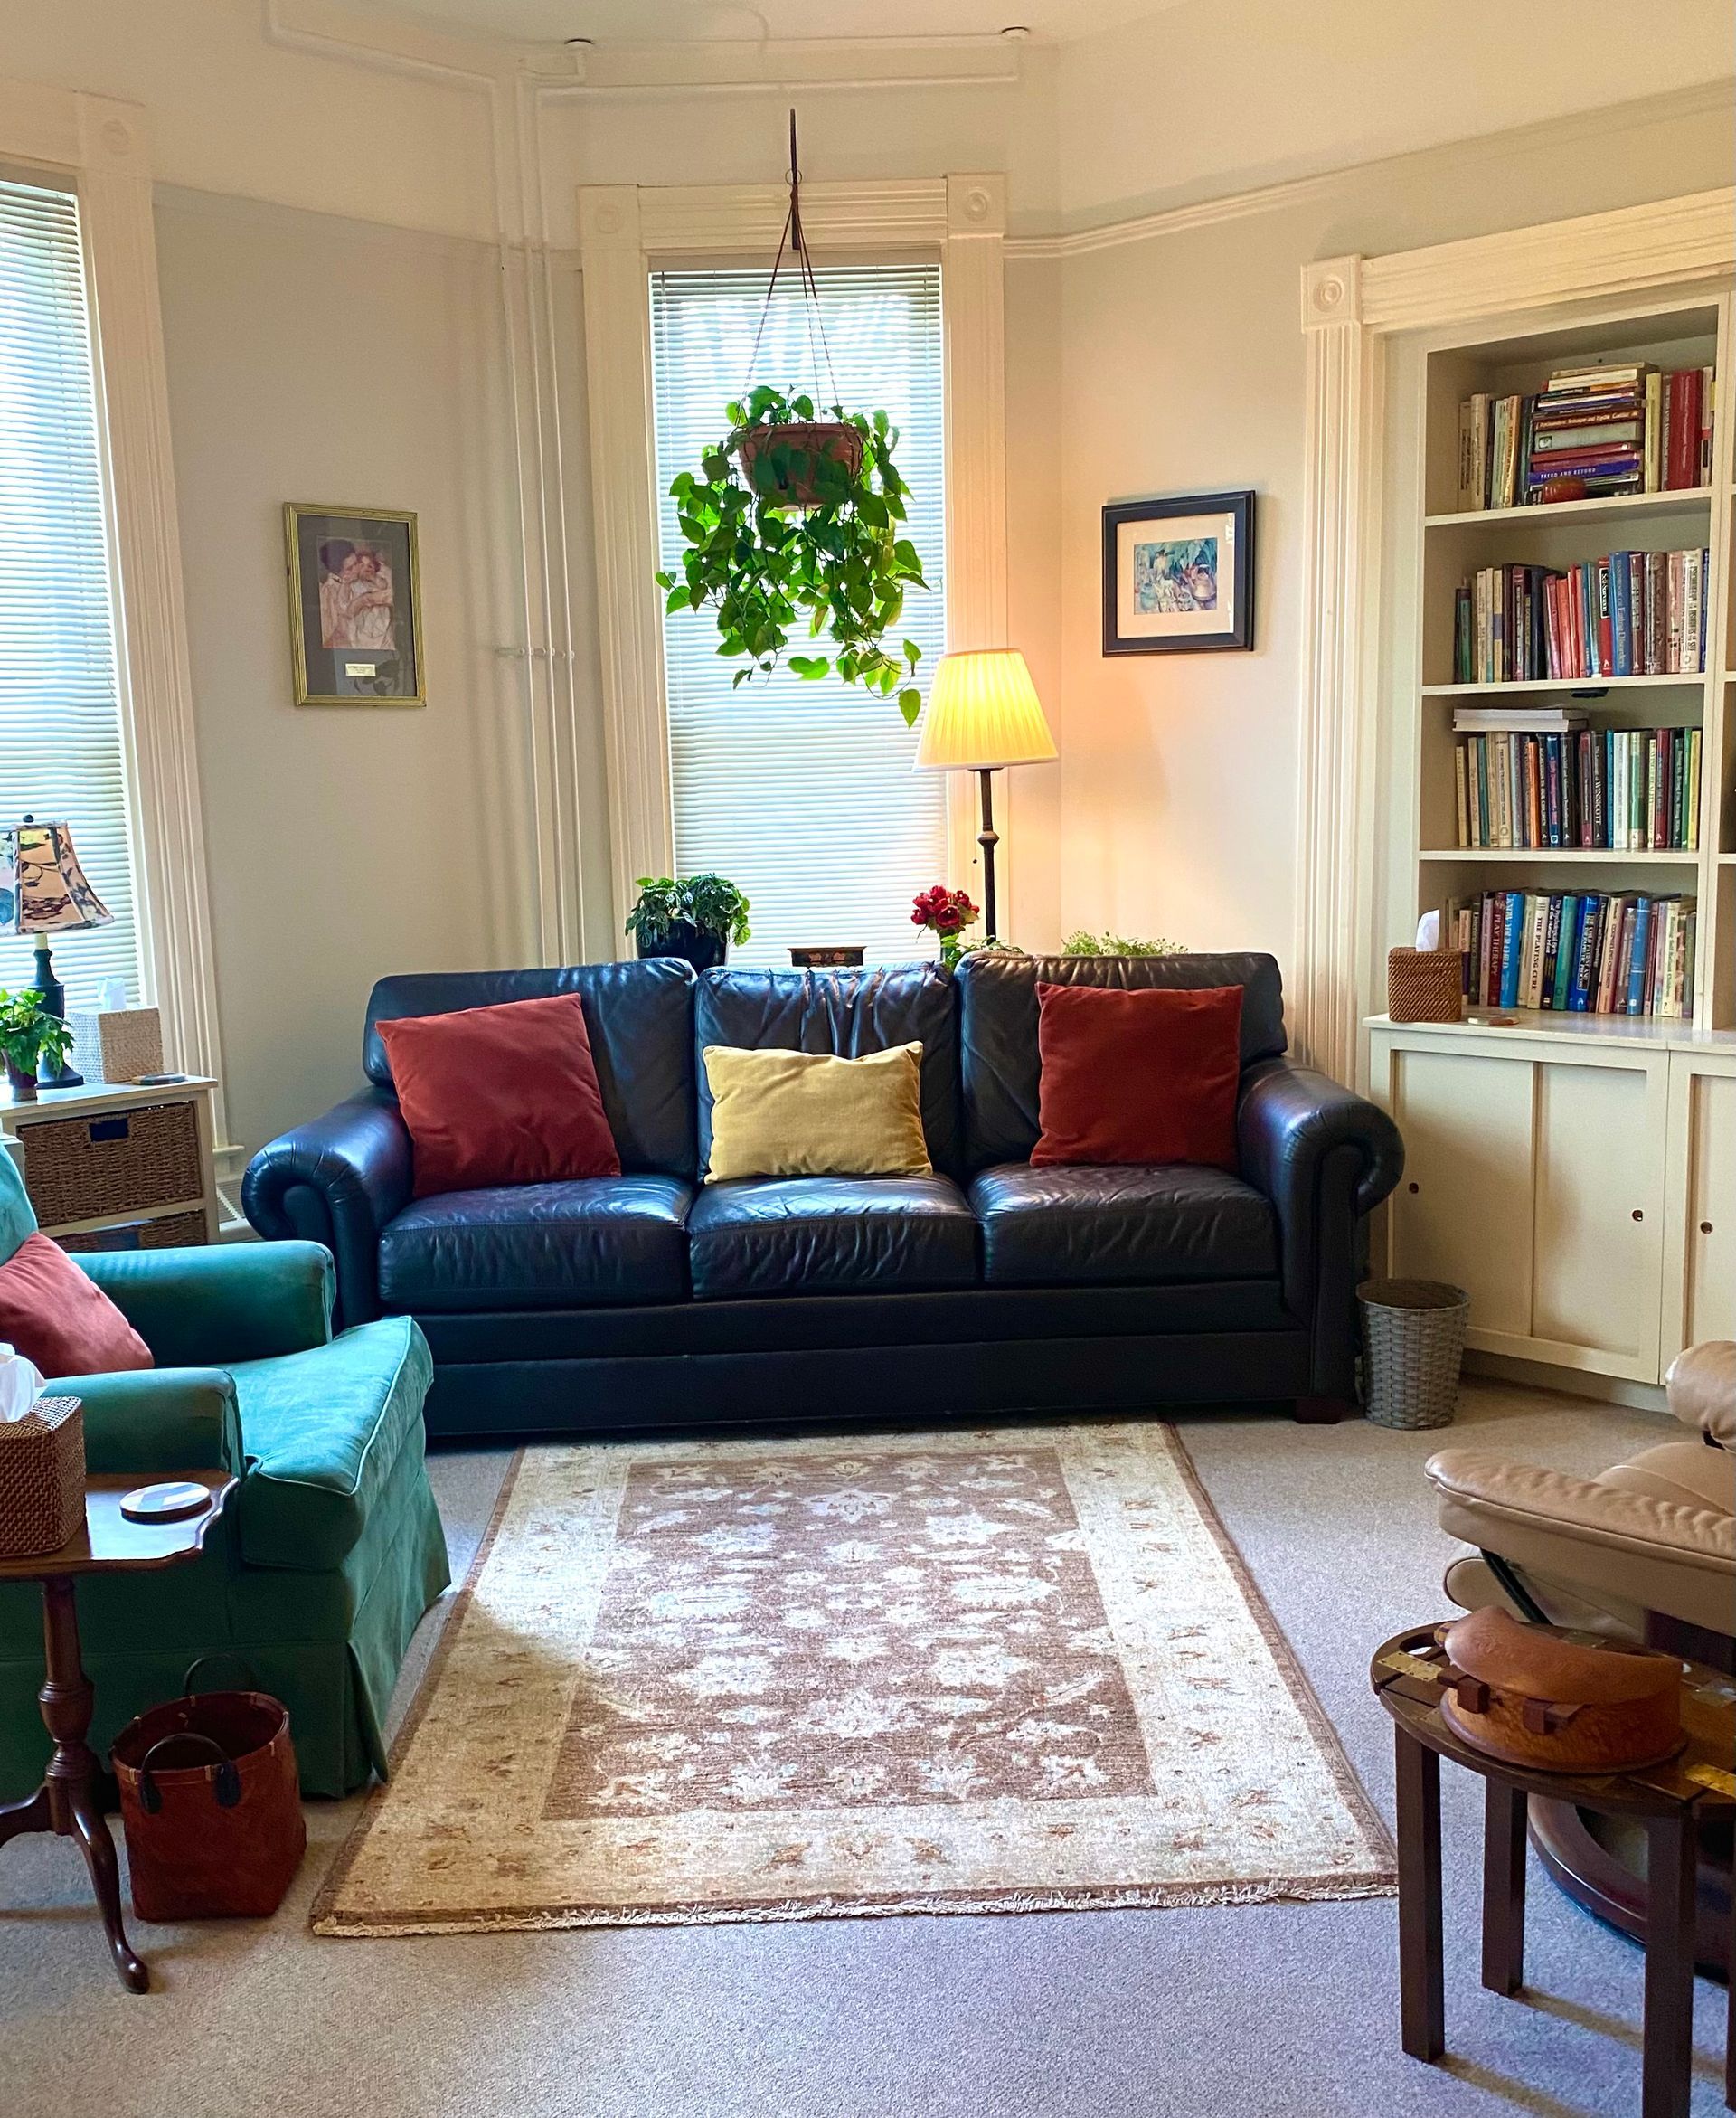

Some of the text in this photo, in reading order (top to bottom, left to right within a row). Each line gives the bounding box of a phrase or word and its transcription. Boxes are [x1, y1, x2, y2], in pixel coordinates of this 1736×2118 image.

[1618, 607, 1626, 631] Eating
[1504, 923, 1512, 944] YOUR
[1552, 910, 1561, 941] Psychological
[1491, 938, 1500, 976] THERAPY
[1533, 935, 1542, 968] PLAYING
